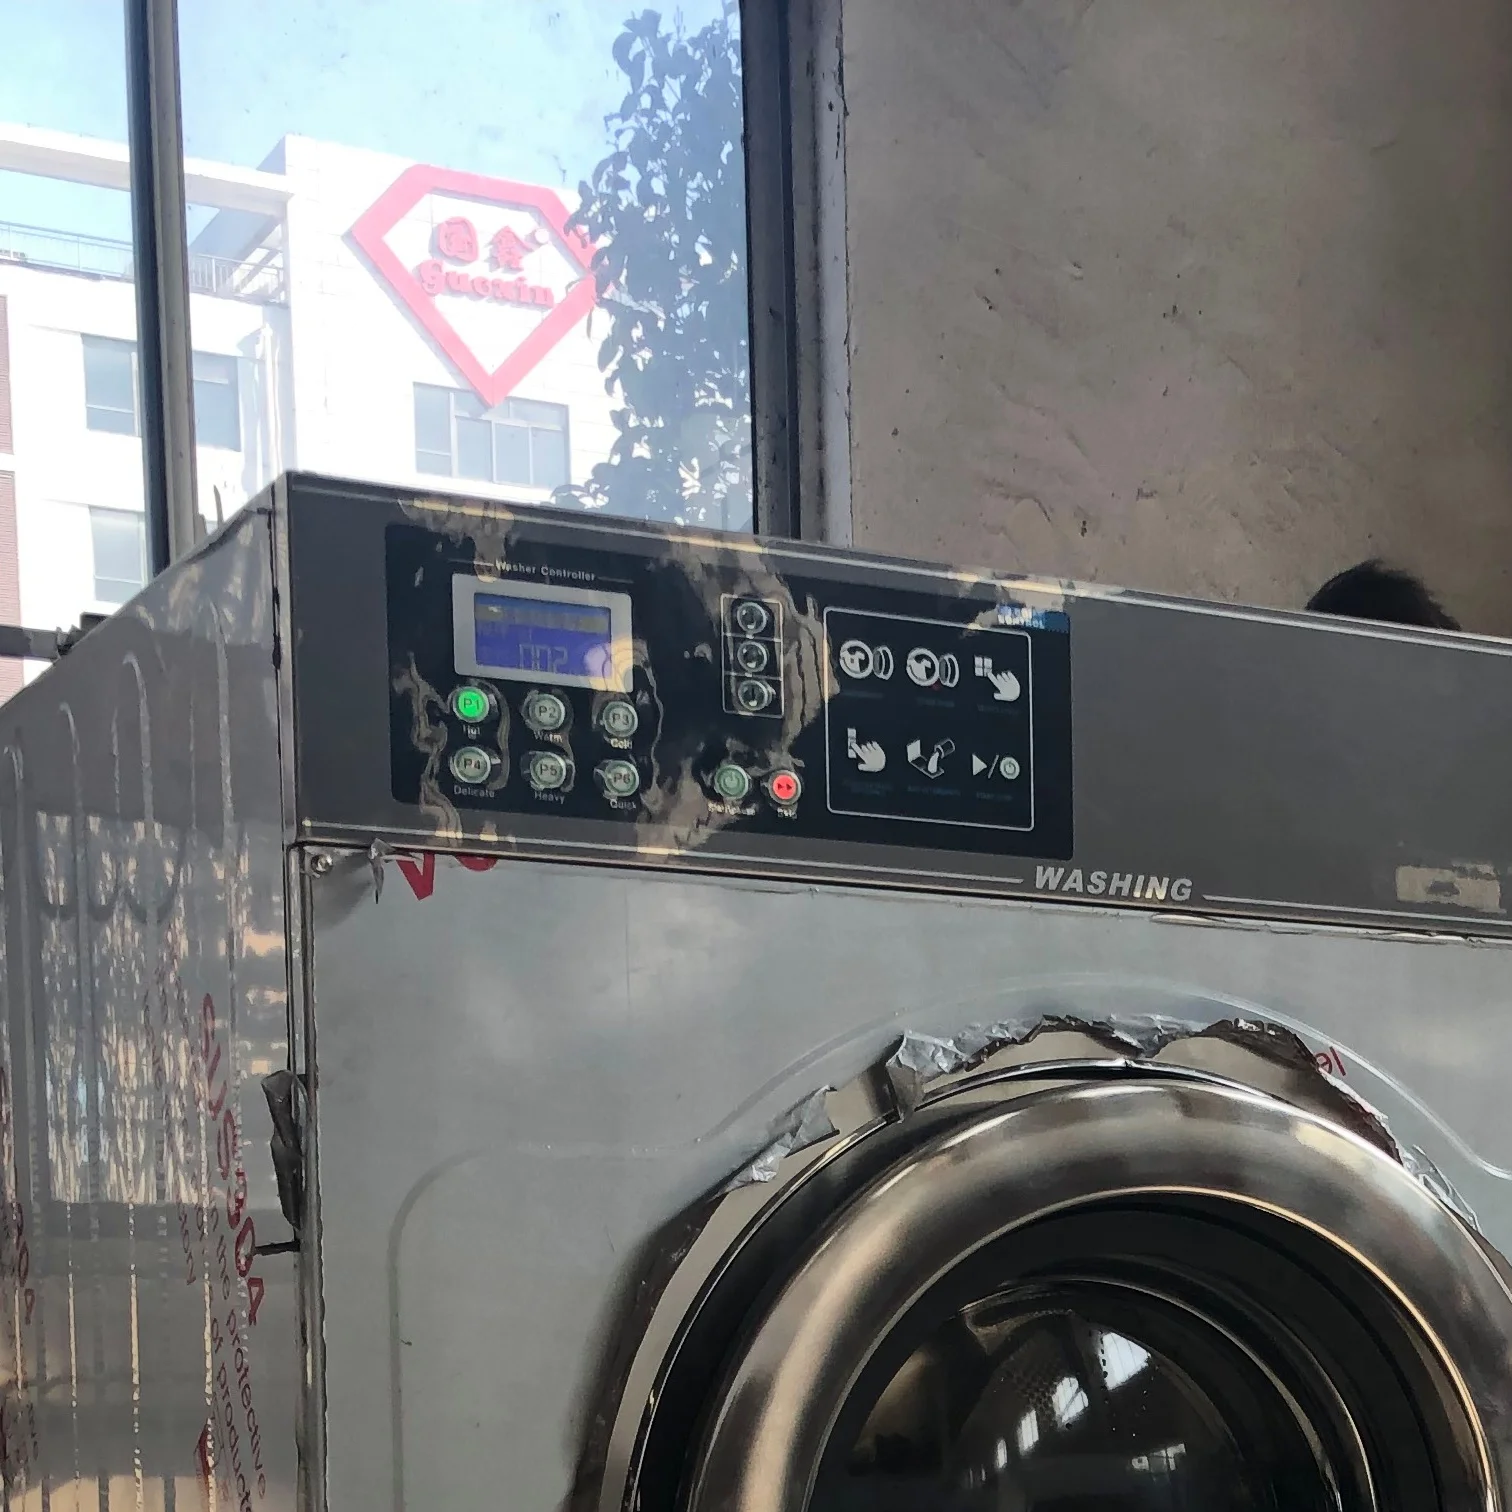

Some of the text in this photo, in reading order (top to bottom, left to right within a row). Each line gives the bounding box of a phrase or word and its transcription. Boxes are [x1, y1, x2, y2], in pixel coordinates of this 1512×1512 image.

[495, 559, 596, 582] Washer Controller
[463, 697, 481, 710] P1
[538, 705, 557, 719] P2
[612, 712, 630, 726] P3
[463, 757, 481, 770] P4
[539, 763, 558, 776] P5
[613, 771, 631, 784] P6
[453, 784, 495, 799] Delicate
[534, 791, 565, 805] Heavy
[1035, 865, 1193, 901] WASHING
[210, 1317, 224, 1355] of
[226, 1309, 267, 1500] protective
